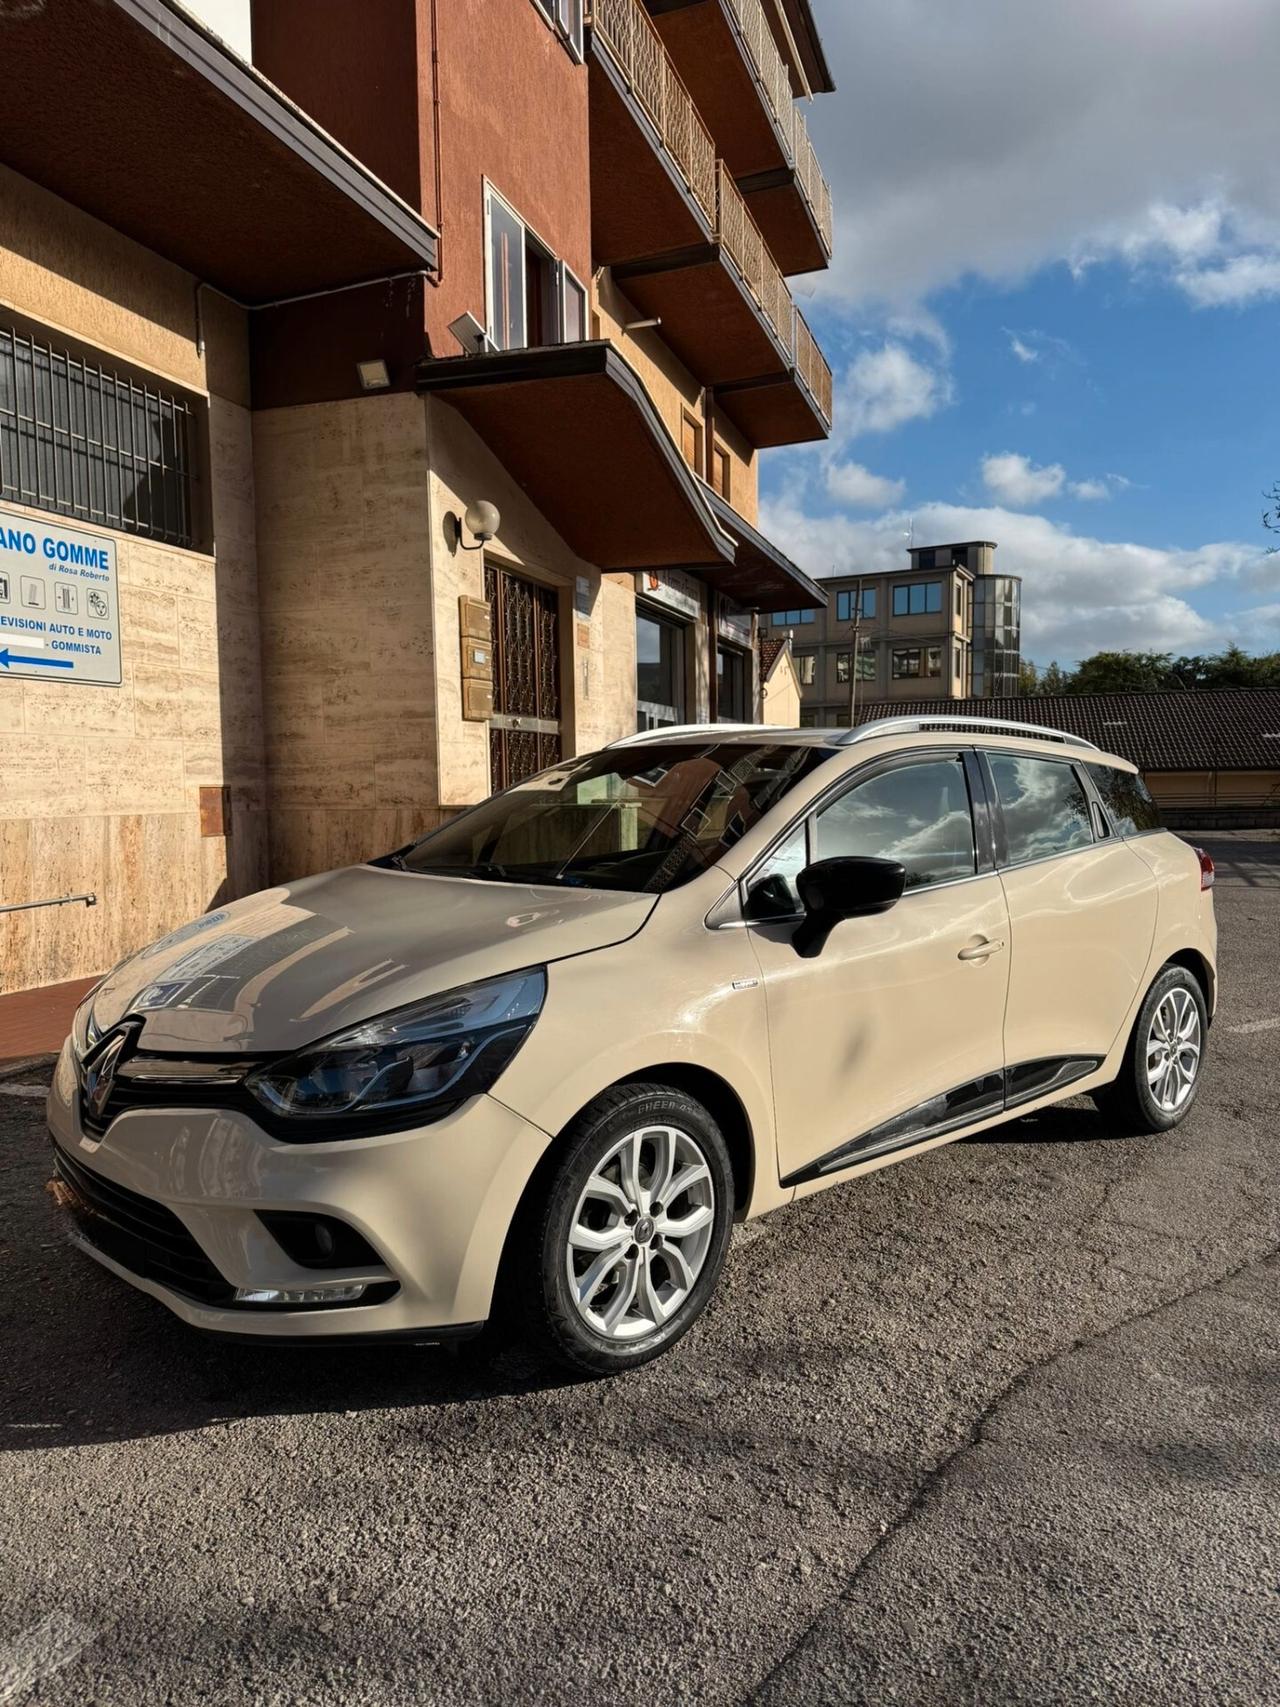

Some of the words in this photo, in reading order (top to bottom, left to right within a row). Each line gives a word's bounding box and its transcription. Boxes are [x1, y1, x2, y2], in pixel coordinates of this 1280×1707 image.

[43, 537, 109, 570] GOMME
[49, 563, 57, 571] di
[59, 565, 78, 575] Rosa
[80, 569, 110, 582] Roberto
[0, 615, 46, 631] EVISIONI
[49, 623, 75, 635] AUTO
[78, 627, 84, 637] E
[86, 629, 112, 641] MOTO
[51, 640, 102, 655] GOMMISTA
